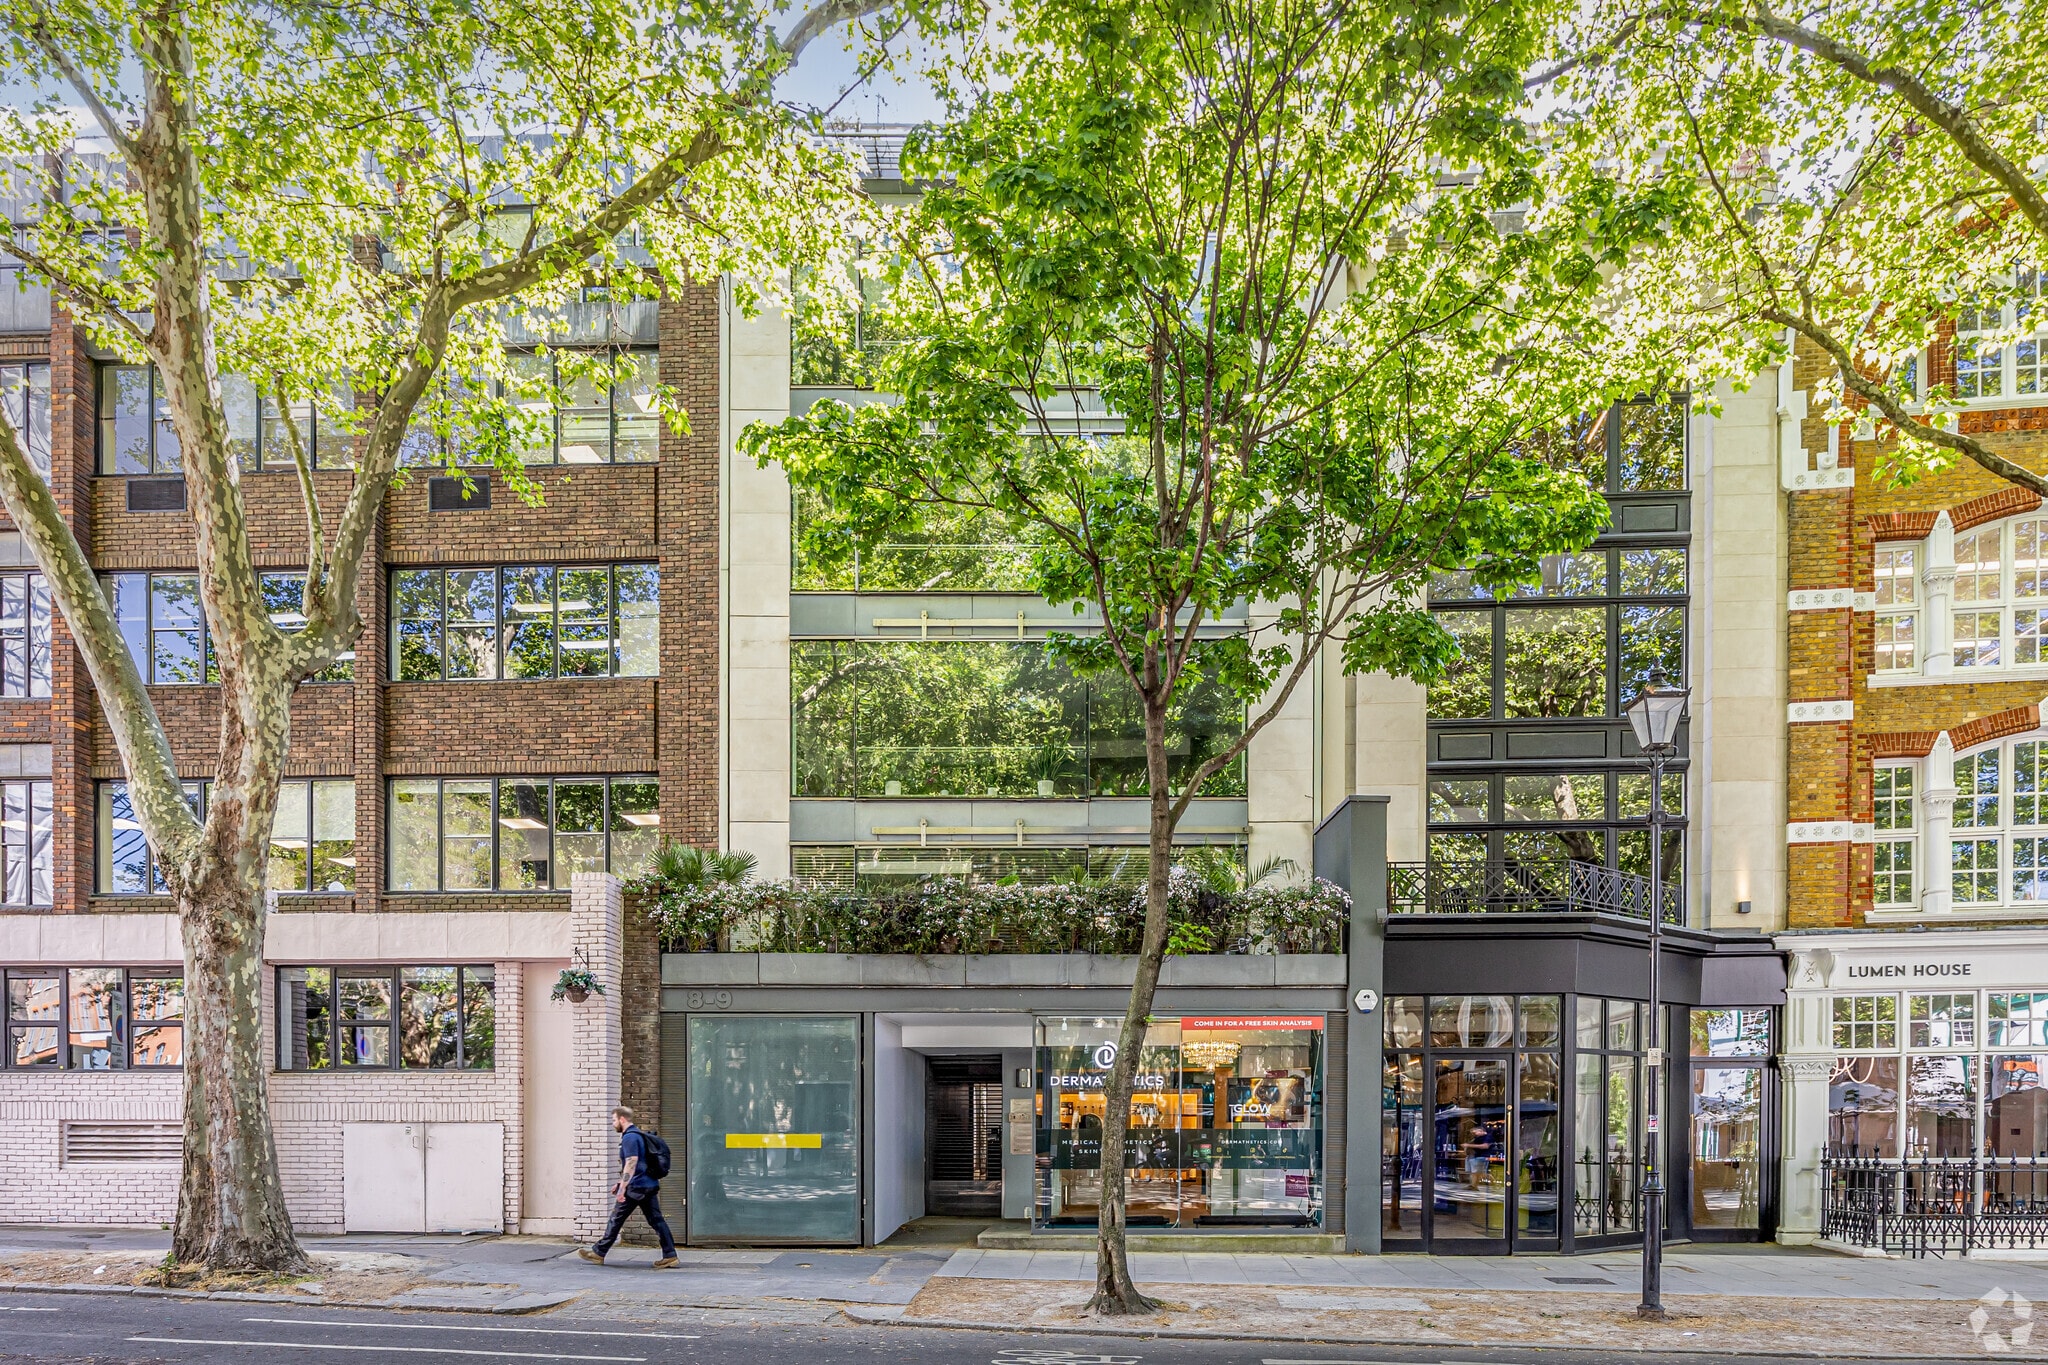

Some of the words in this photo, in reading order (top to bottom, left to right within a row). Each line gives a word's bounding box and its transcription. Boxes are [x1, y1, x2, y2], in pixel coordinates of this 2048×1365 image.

[1849, 965, 1906, 977] LUMEN
[1913, 963, 1971, 976] HOUSE
[687, 990, 733, 1009] 8-9
[1050, 1076, 1164, 1086] DERMATICS
[1234, 1103, 1272, 1113] GLOW
